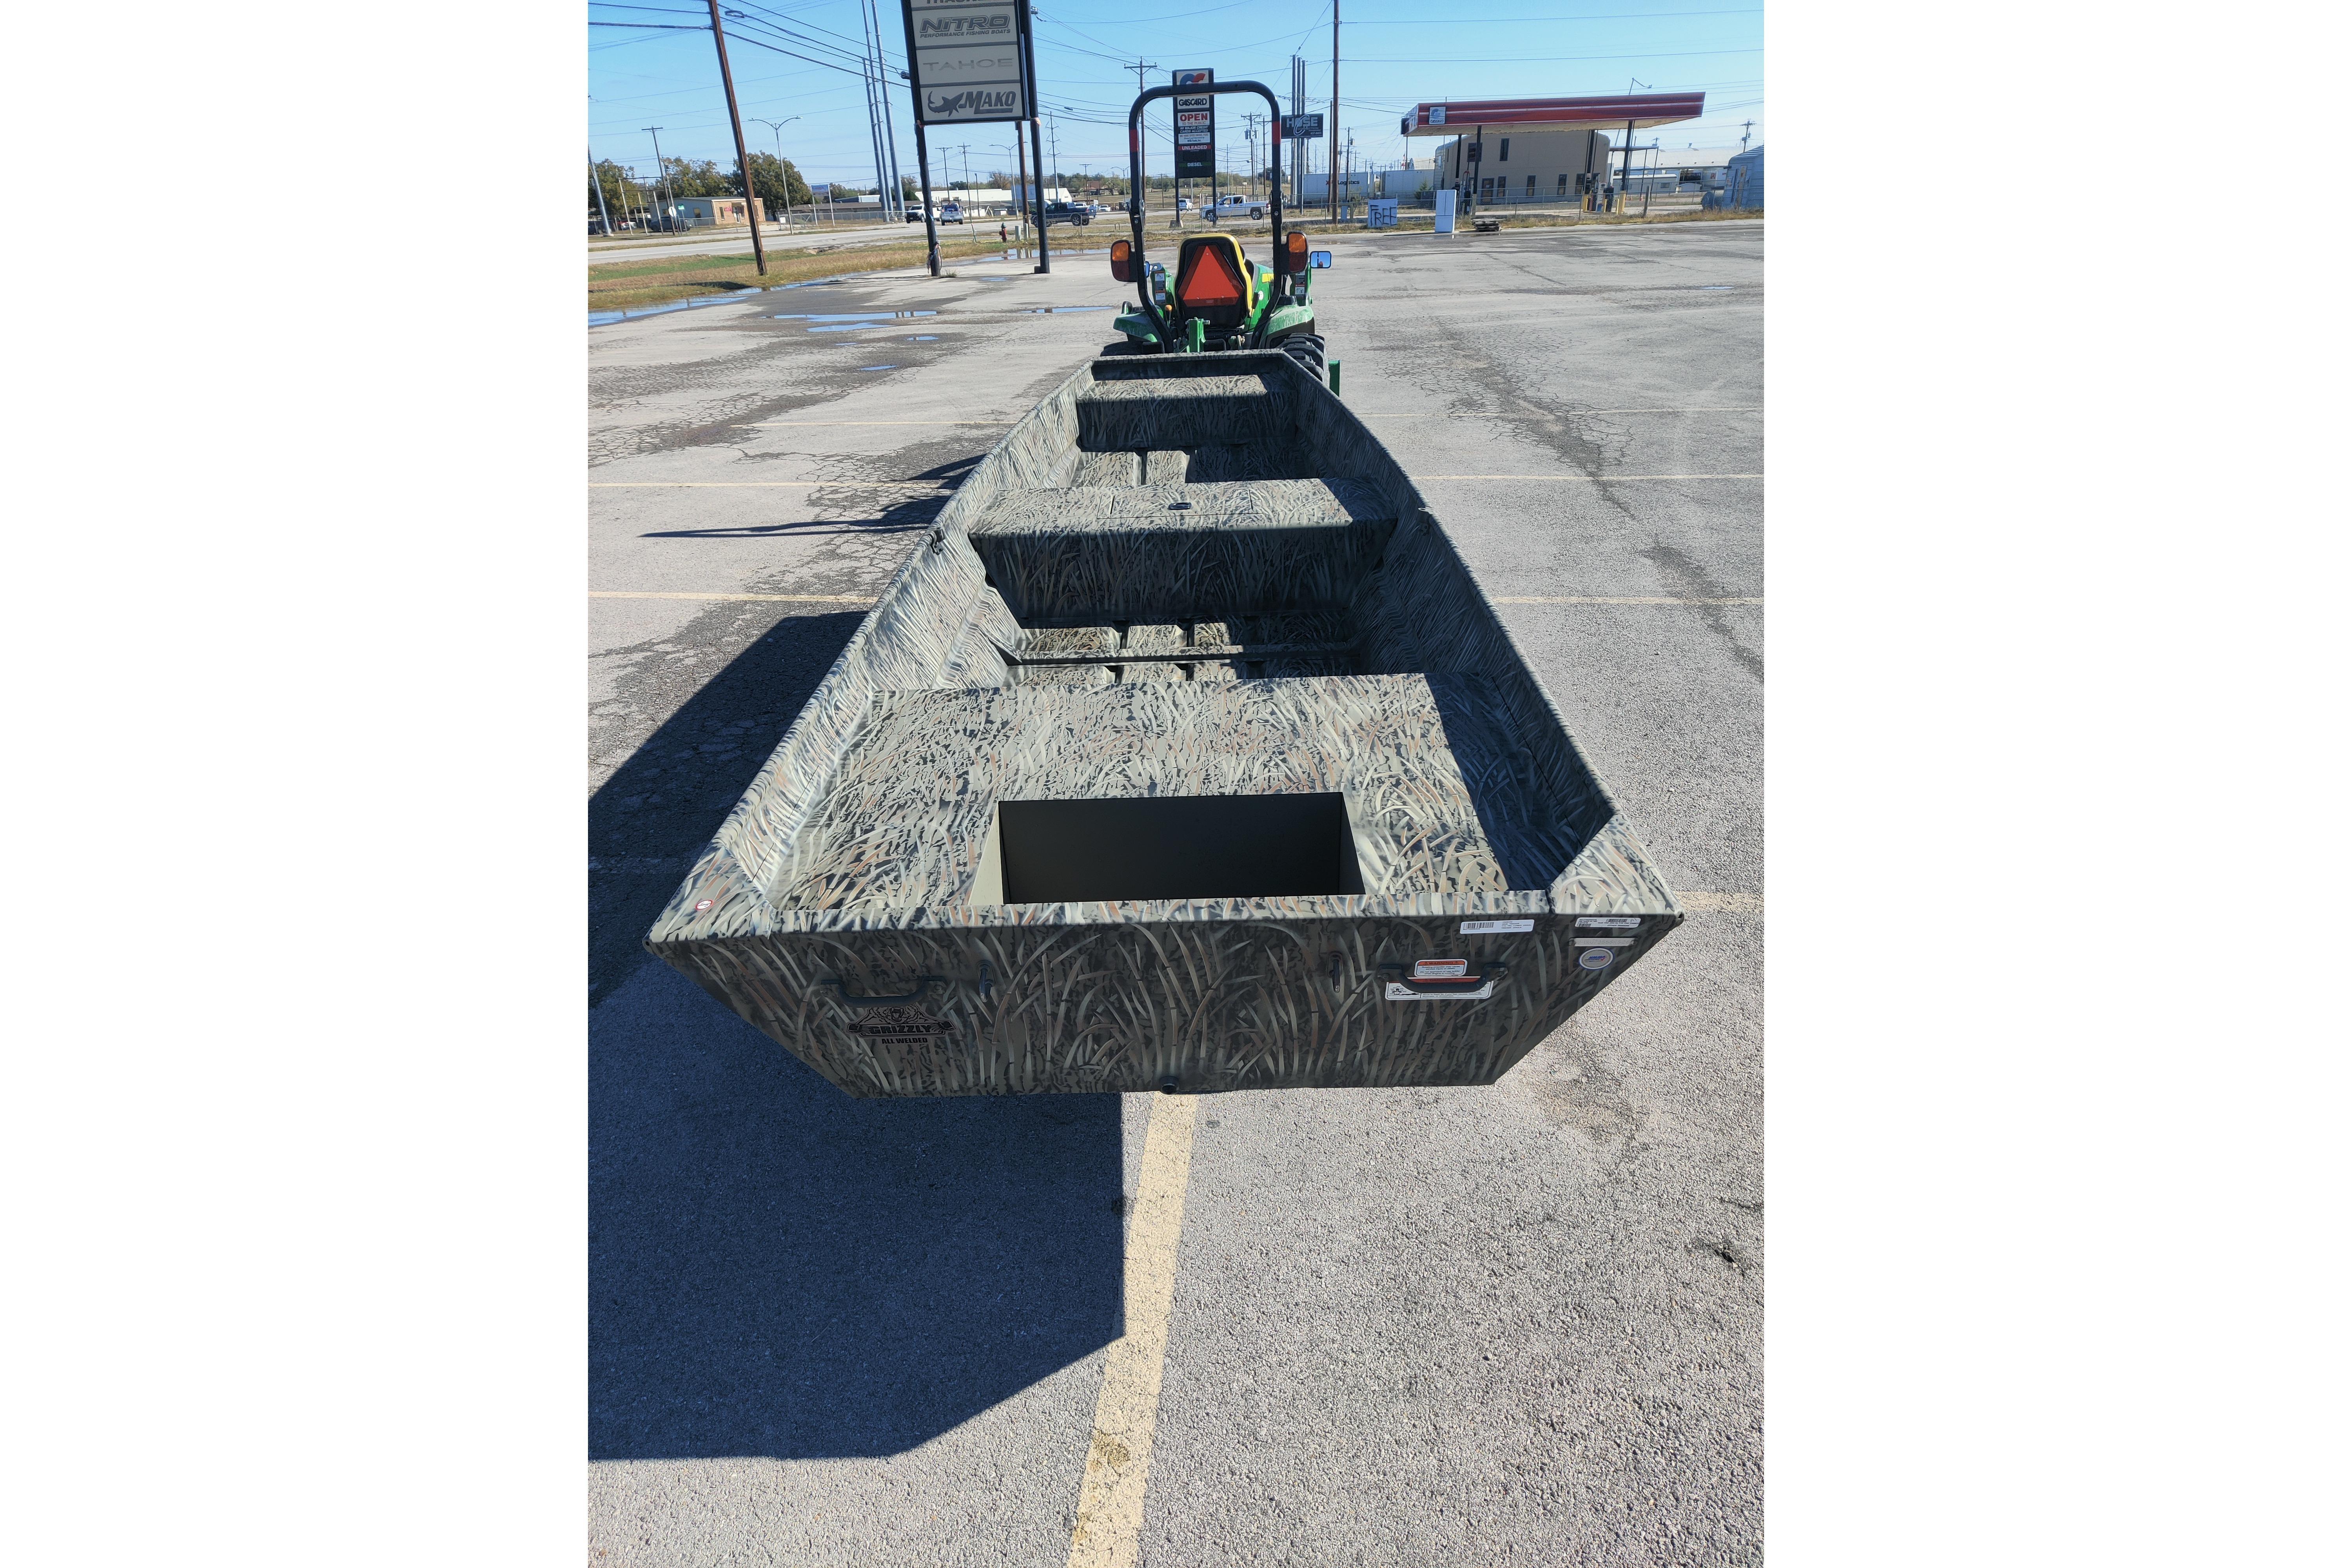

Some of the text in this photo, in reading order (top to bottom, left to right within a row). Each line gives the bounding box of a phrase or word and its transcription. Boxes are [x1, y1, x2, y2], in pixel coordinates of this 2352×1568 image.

[920, 14, 1010, 33] NITRO
[923, 58, 1013, 71] TAHOE
[958, 91, 1016, 114] MAKO
[1180, 113, 1208, 122] OPEN
[1287, 117, 1318, 127] HOSE
[1370, 205, 1397, 226] FREE
[870, 1024, 933, 1034] GRIZZLY
